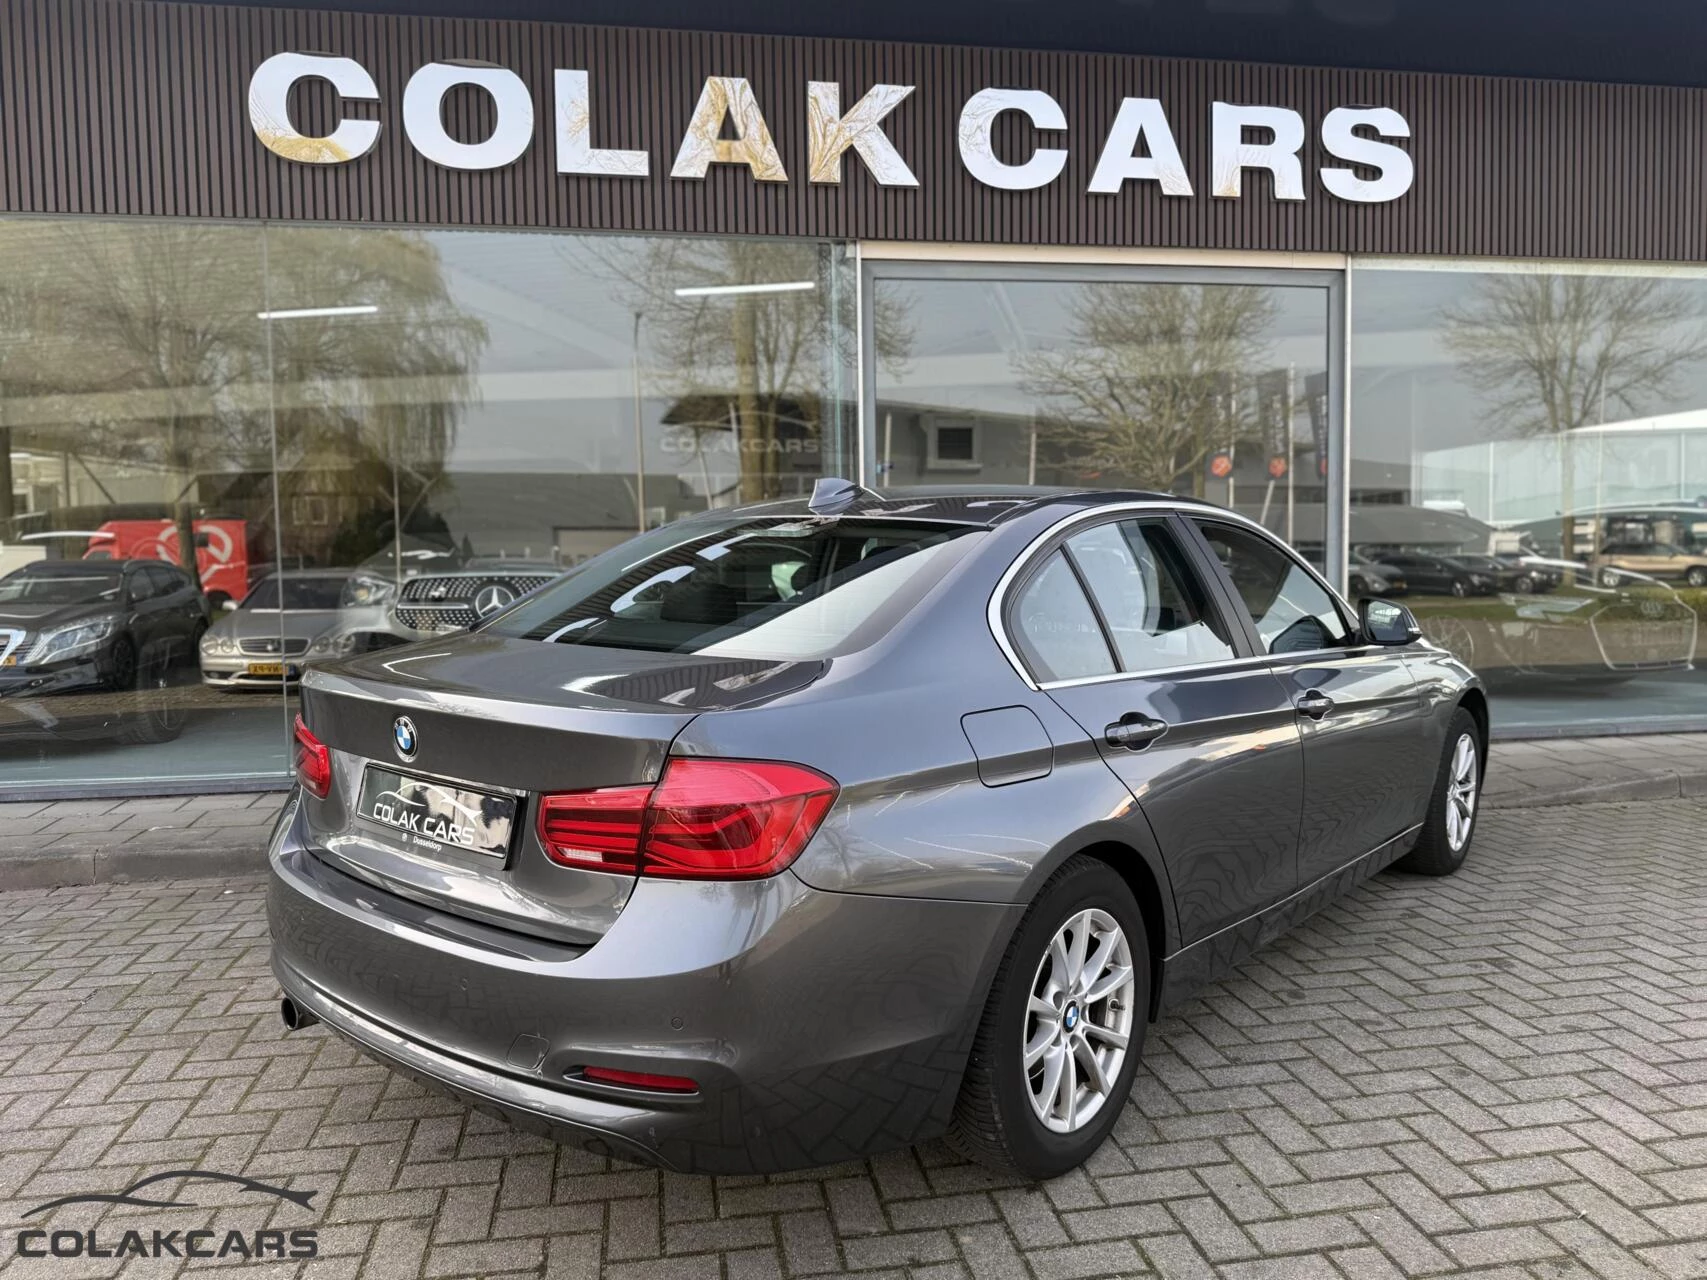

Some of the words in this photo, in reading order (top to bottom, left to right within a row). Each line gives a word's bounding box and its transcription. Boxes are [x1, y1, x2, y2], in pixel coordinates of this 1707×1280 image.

[248, 51, 921, 188] COLAK
[957, 86, 1414, 203] CARS
[373, 803, 418, 832] COLAK
[423, 818, 475, 846] CARS
